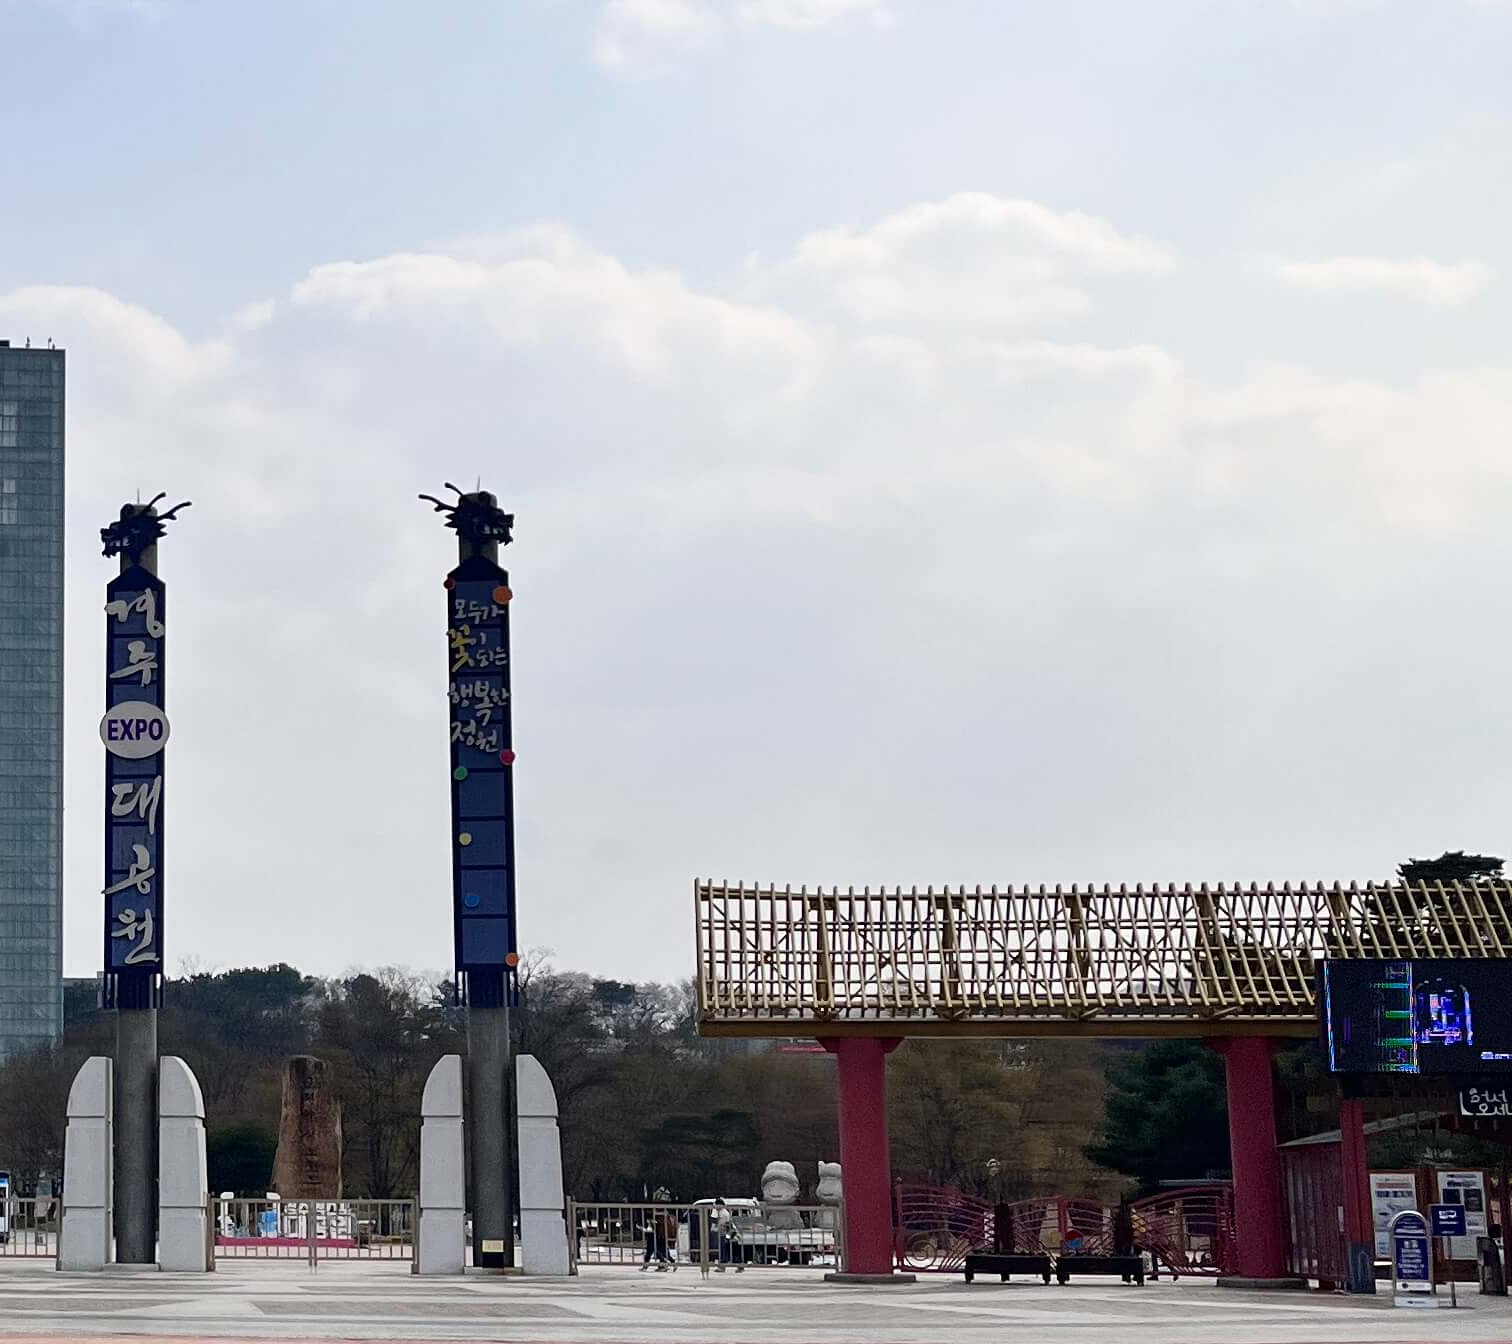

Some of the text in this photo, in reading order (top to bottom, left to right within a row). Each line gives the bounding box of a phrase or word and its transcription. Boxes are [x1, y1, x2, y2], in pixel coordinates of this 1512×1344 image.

[454, 599, 505, 625] 모두가
[476, 646, 508, 667] 되는
[447, 680, 512, 726] 행복한
[451, 720, 499, 753] 정원
[101, 588, 165, 965] 경주 EXPO 대공원
